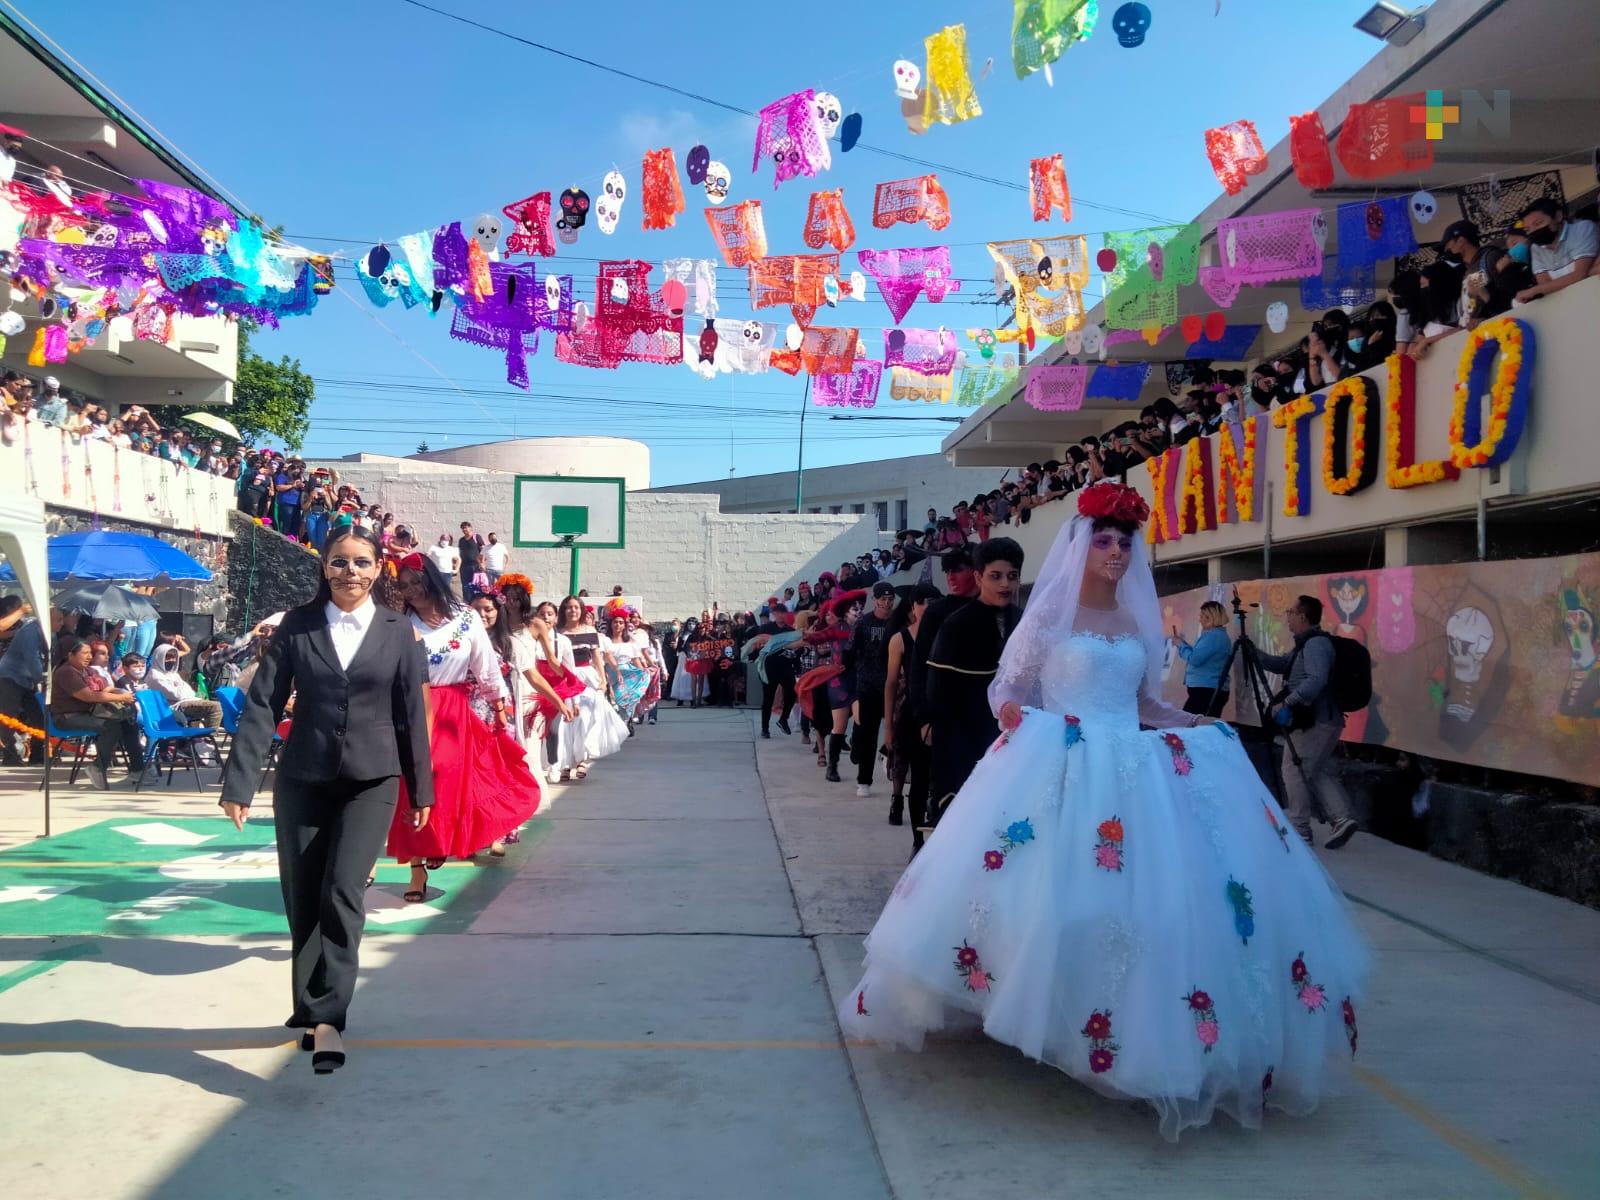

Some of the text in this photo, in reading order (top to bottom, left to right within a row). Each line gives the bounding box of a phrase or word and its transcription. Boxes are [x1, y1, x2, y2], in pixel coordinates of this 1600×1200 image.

[1146, 316, 1537, 545] XANTOLO
[689, 639, 735, 651] TURISMO
[106, 882, 227, 920] PUNTO
